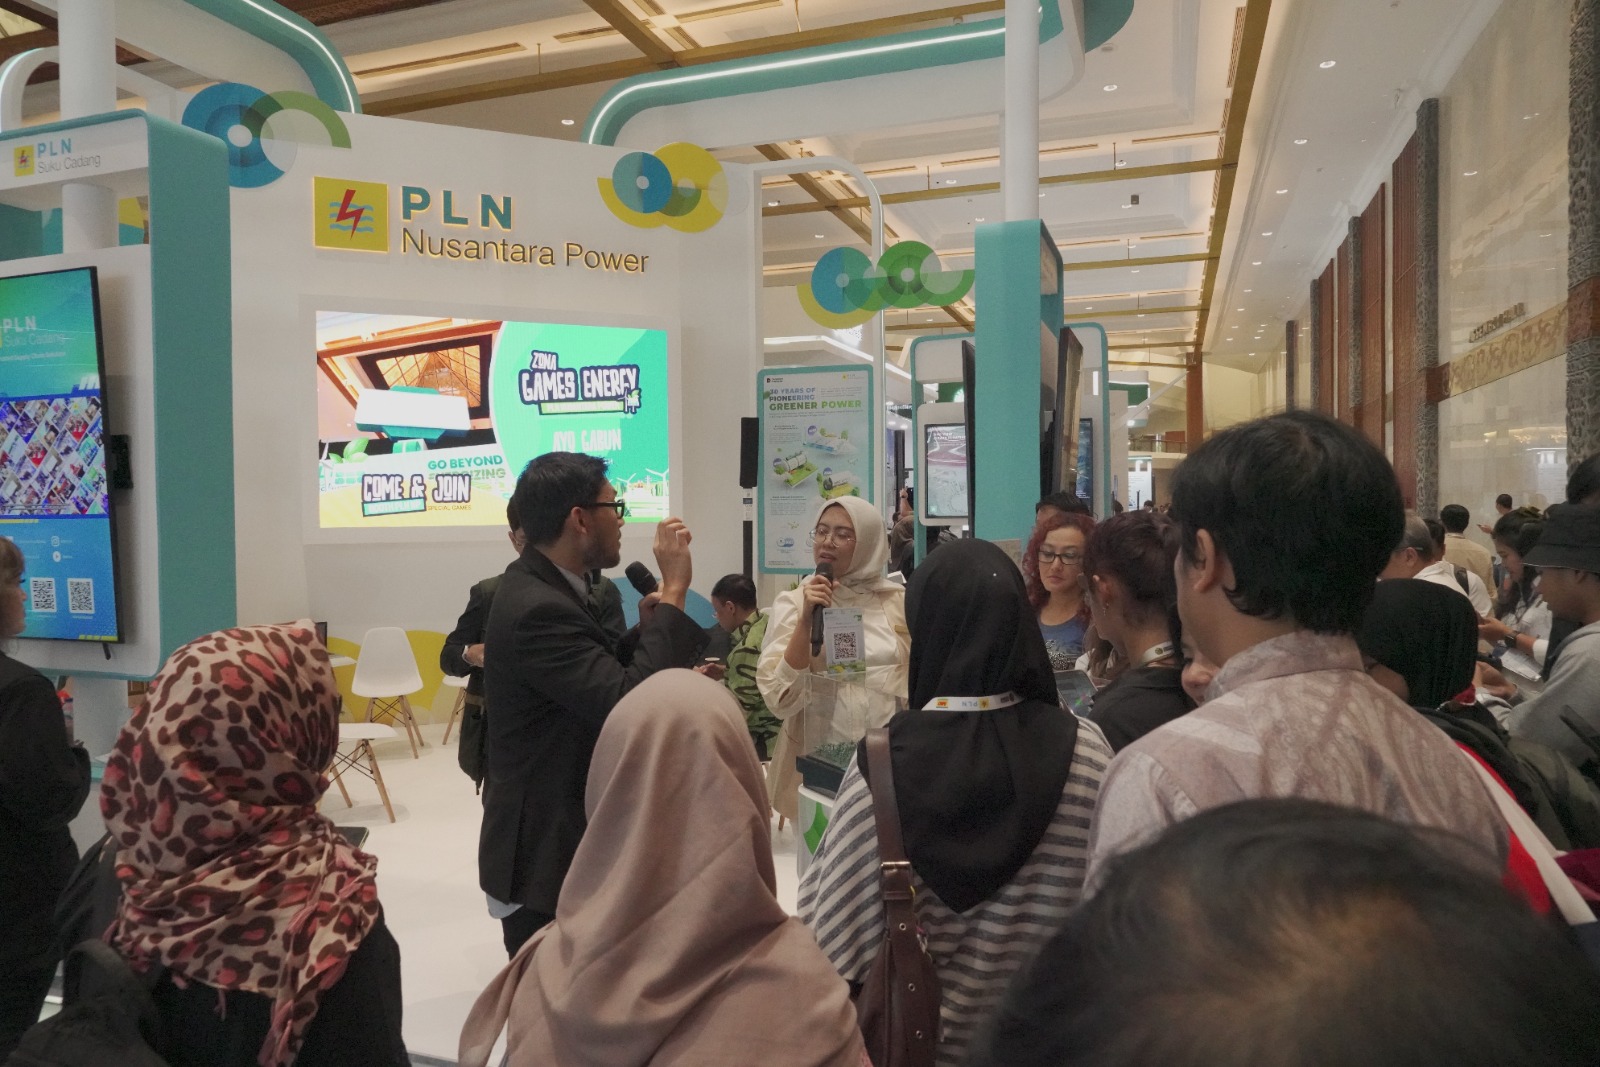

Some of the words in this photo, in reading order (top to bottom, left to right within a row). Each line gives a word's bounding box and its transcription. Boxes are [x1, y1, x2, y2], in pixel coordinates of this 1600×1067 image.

[37, 138, 72, 158] PLN
[38, 161, 61, 174] Suku
[64, 155, 101, 170] Cadang
[402, 185, 512, 230] PLN
[402, 227, 556, 266] Nusantara
[565, 243, 649, 273] Power
[3, 316, 36, 333] PLN
[532, 351, 557, 370] ZONA
[521, 371, 576, 402] GAMES
[769, 401, 818, 411] GREENER
[821, 399, 862, 409] POWER
[427, 460, 447, 470] GO
[450, 455, 503, 468] BEYOND
[363, 475, 404, 502] COME
[410, 474, 425, 499] &
[433, 475, 471, 502] JOIN
